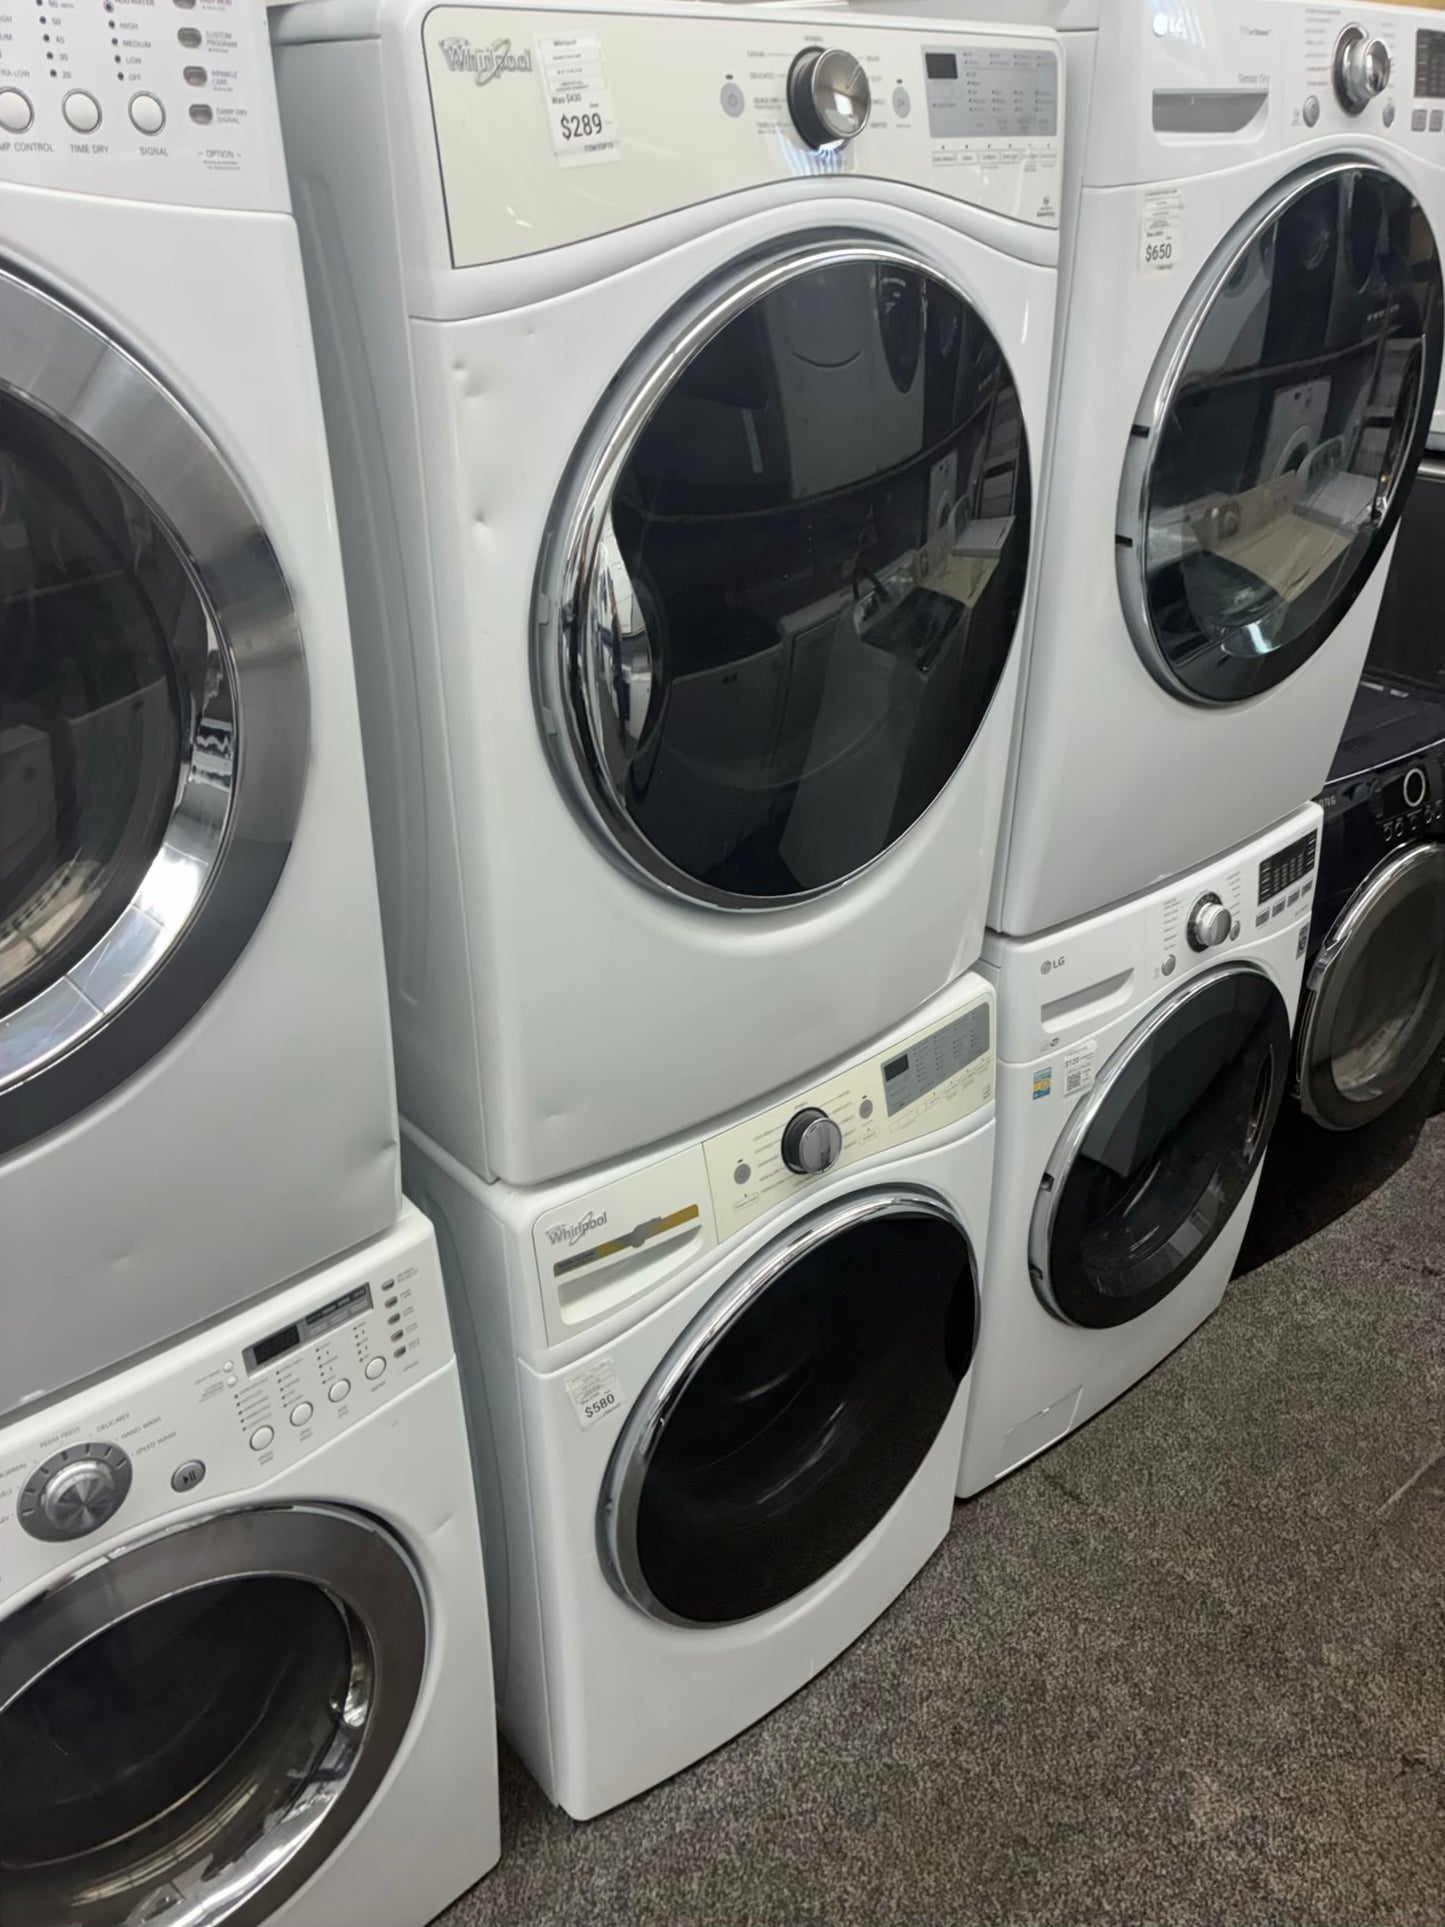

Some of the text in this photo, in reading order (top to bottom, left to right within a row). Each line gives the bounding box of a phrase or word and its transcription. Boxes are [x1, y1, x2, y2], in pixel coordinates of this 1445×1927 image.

[123, 41, 152, 49] MEDIUM
[126, 57, 142, 65] LOW
[439, 38, 533, 84] Whirlpool
[560, 112, 603, 141] $289
[14, 142, 55, 152] CONTROL
[69, 144, 110, 154] TIME DRY
[139, 146, 169, 157] SIGNAL
[205, 149, 235, 160] OPTION
[1145, 243, 1172, 263] $650
[1052, 956, 1065, 966] LG
[545, 1212, 608, 1246] Whirlpool
[584, 1392, 615, 1419] $580
[121, 1427, 142, 1440] HAND
